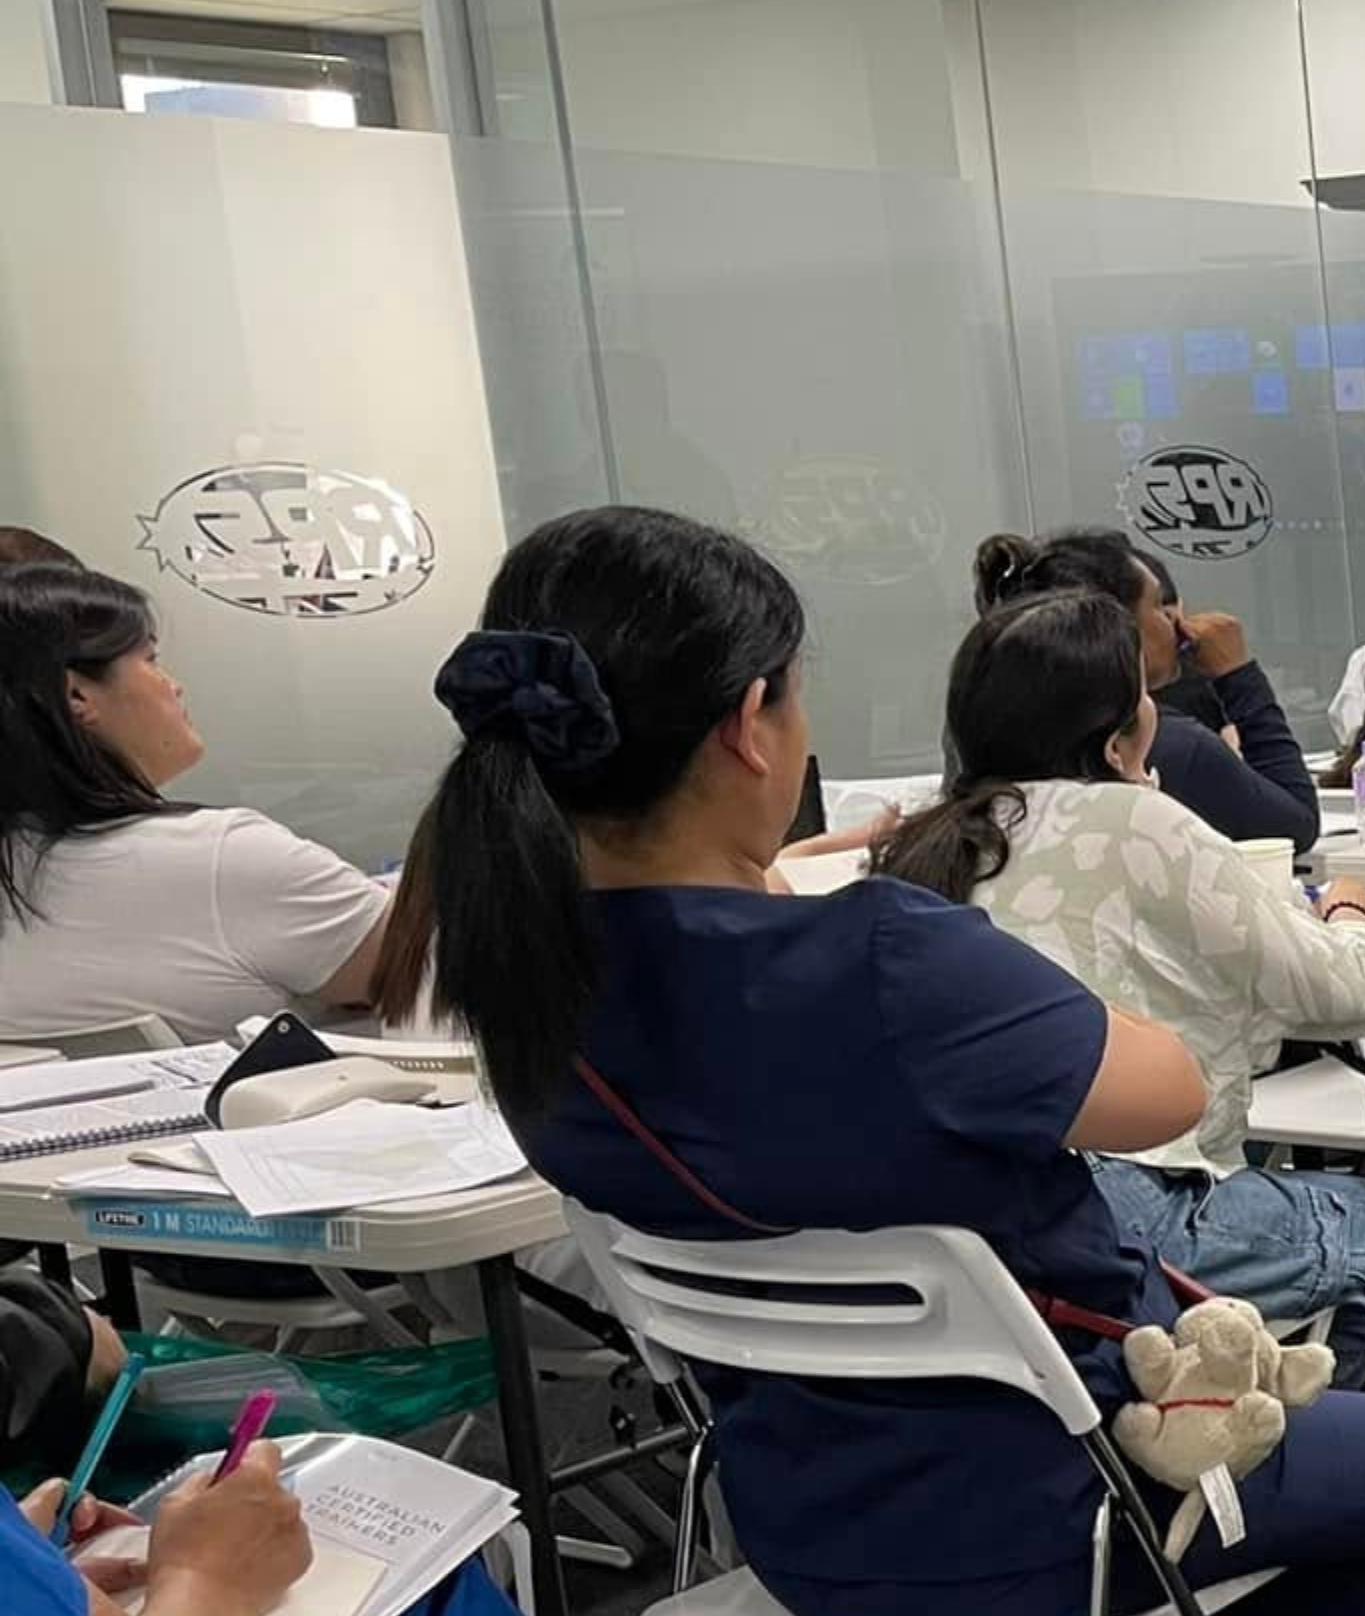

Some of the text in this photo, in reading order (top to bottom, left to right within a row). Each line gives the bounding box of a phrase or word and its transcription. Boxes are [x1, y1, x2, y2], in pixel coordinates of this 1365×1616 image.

[151, 1211, 161, 1231] 1
[164, 1212, 180, 1232] M
[307, 1503, 400, 1546] TRAINERS
[315, 1493, 417, 1538] CERTIFIED
[328, 1484, 447, 1535] AUSTRALIAN
